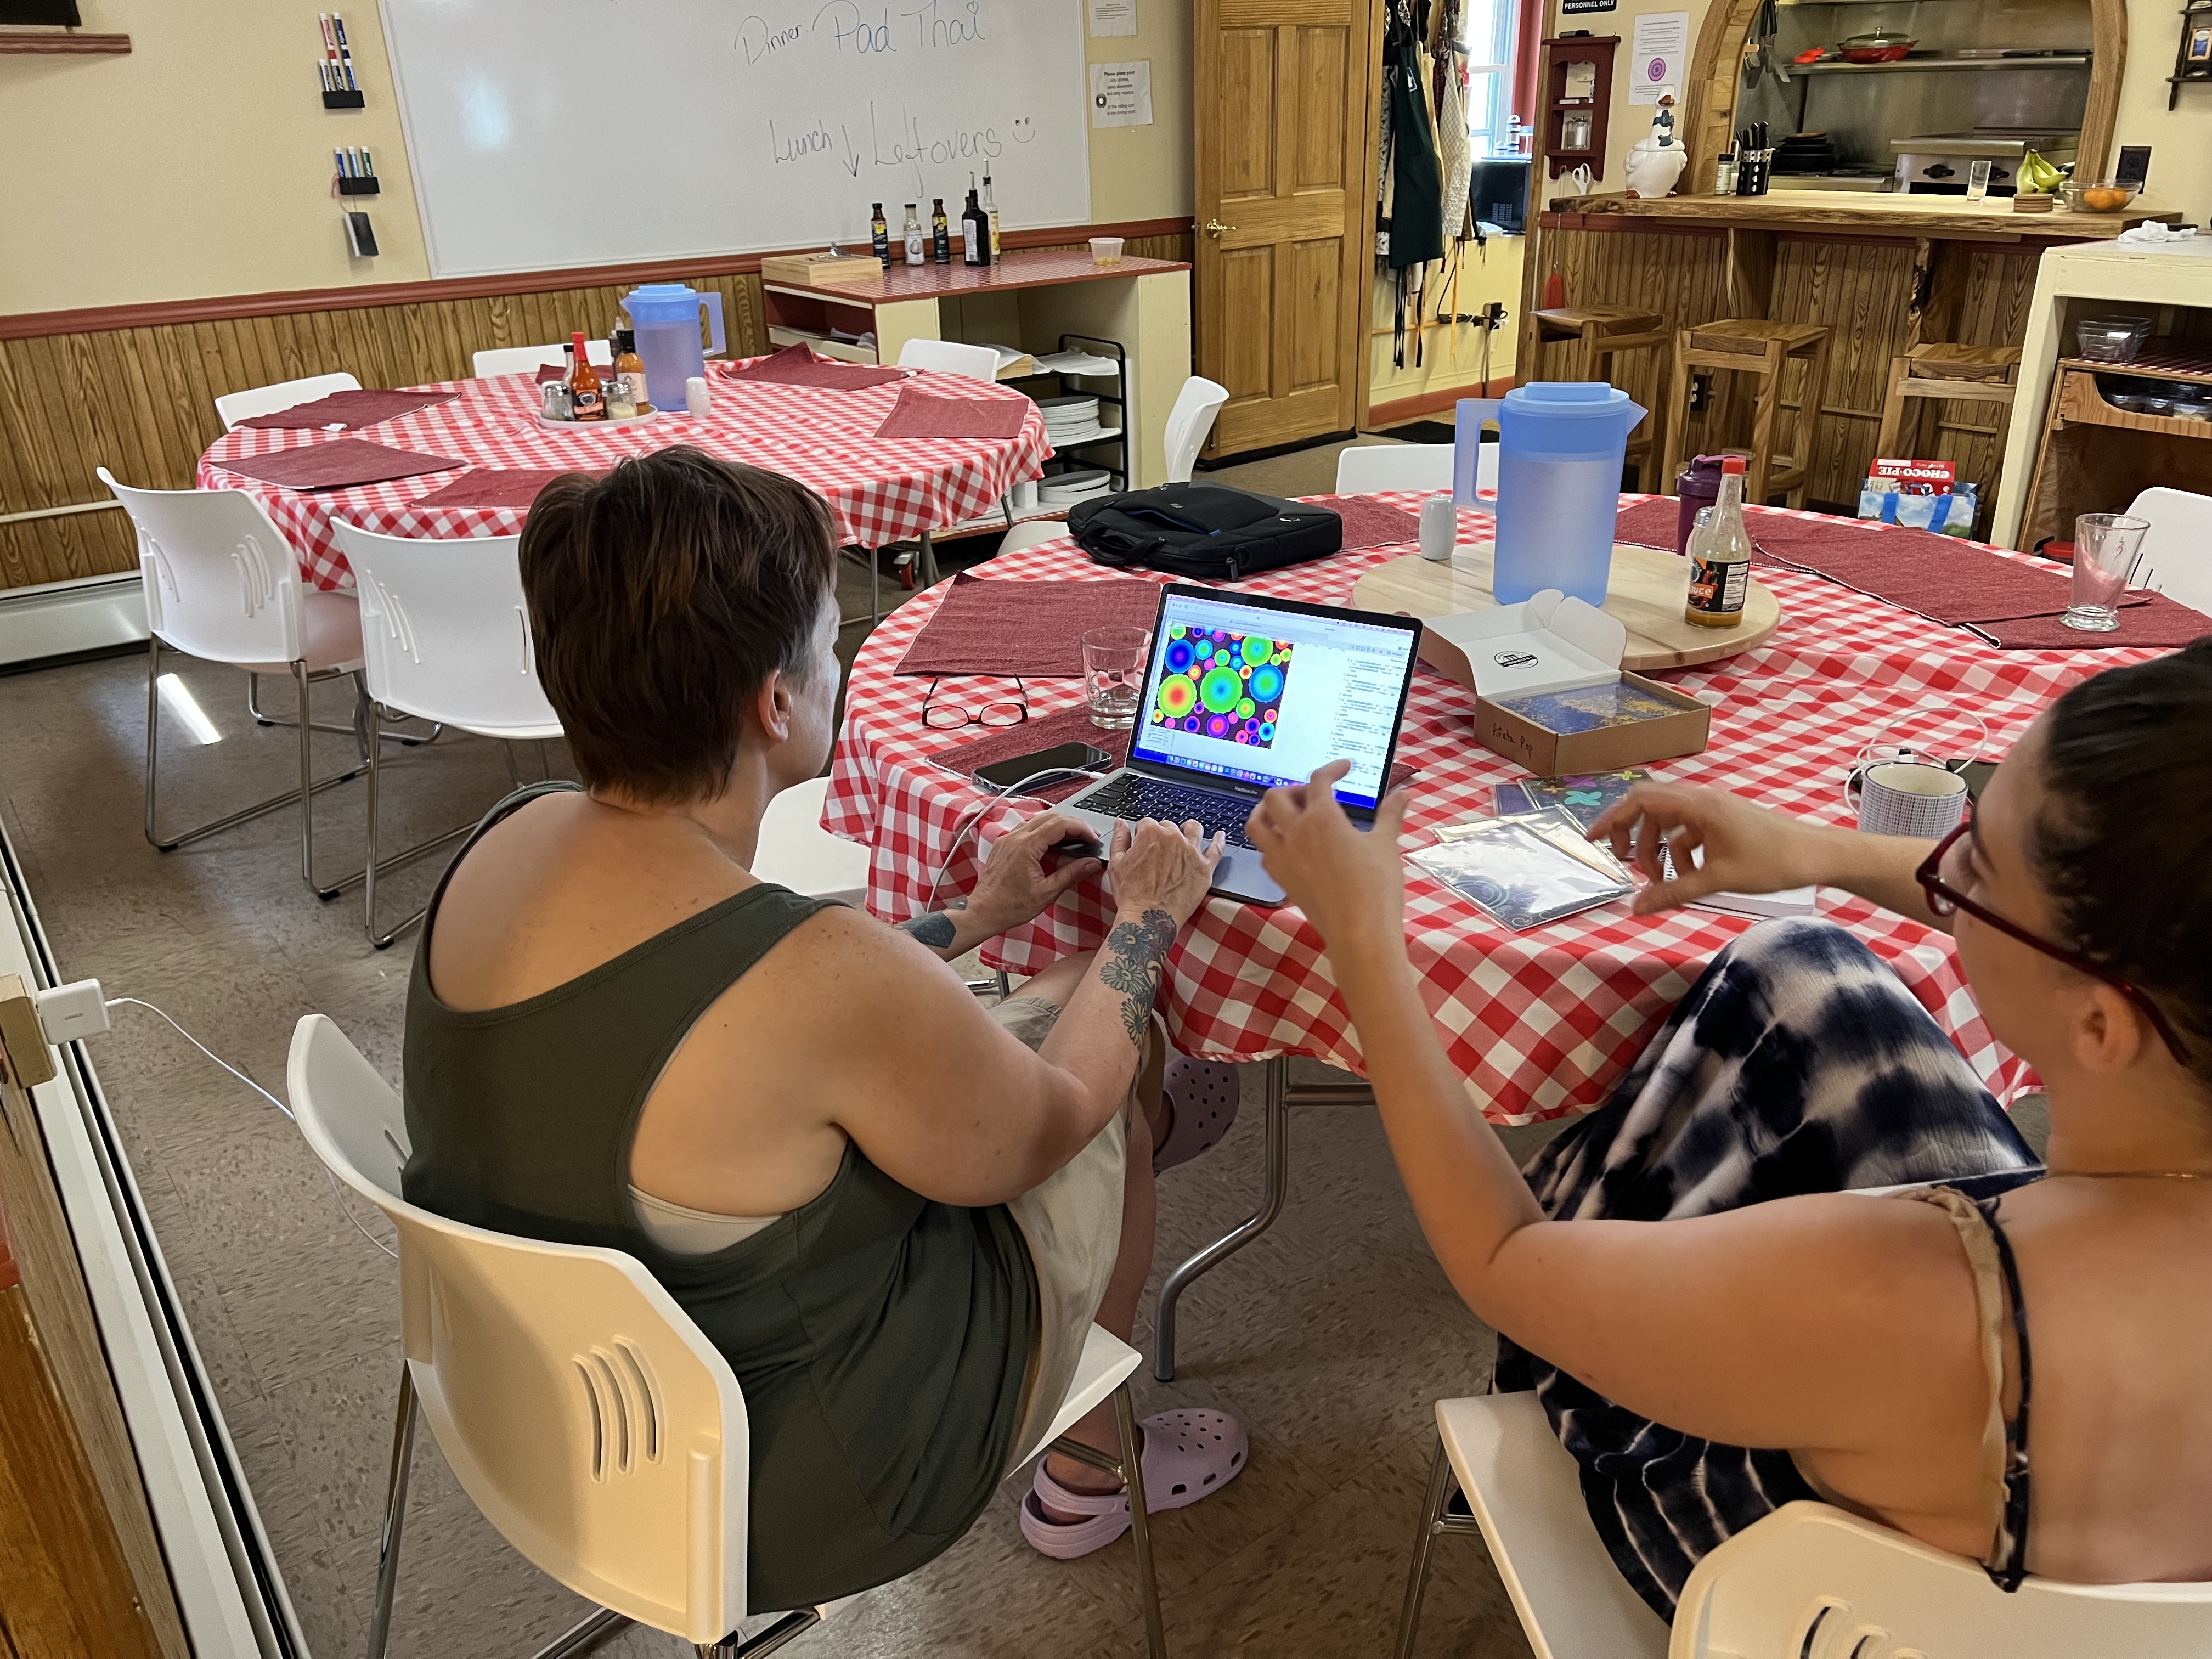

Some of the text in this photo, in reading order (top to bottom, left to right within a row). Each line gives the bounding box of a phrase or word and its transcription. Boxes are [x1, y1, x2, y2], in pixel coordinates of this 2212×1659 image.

[1564, 1, 1598, 9] PERSONNEL
[813, 0, 898, 53] Pad
[900, 0, 985, 49] Thai
[870, 101, 1002, 199] Leftovers
[1521, 736, 1533, 759] Pop
